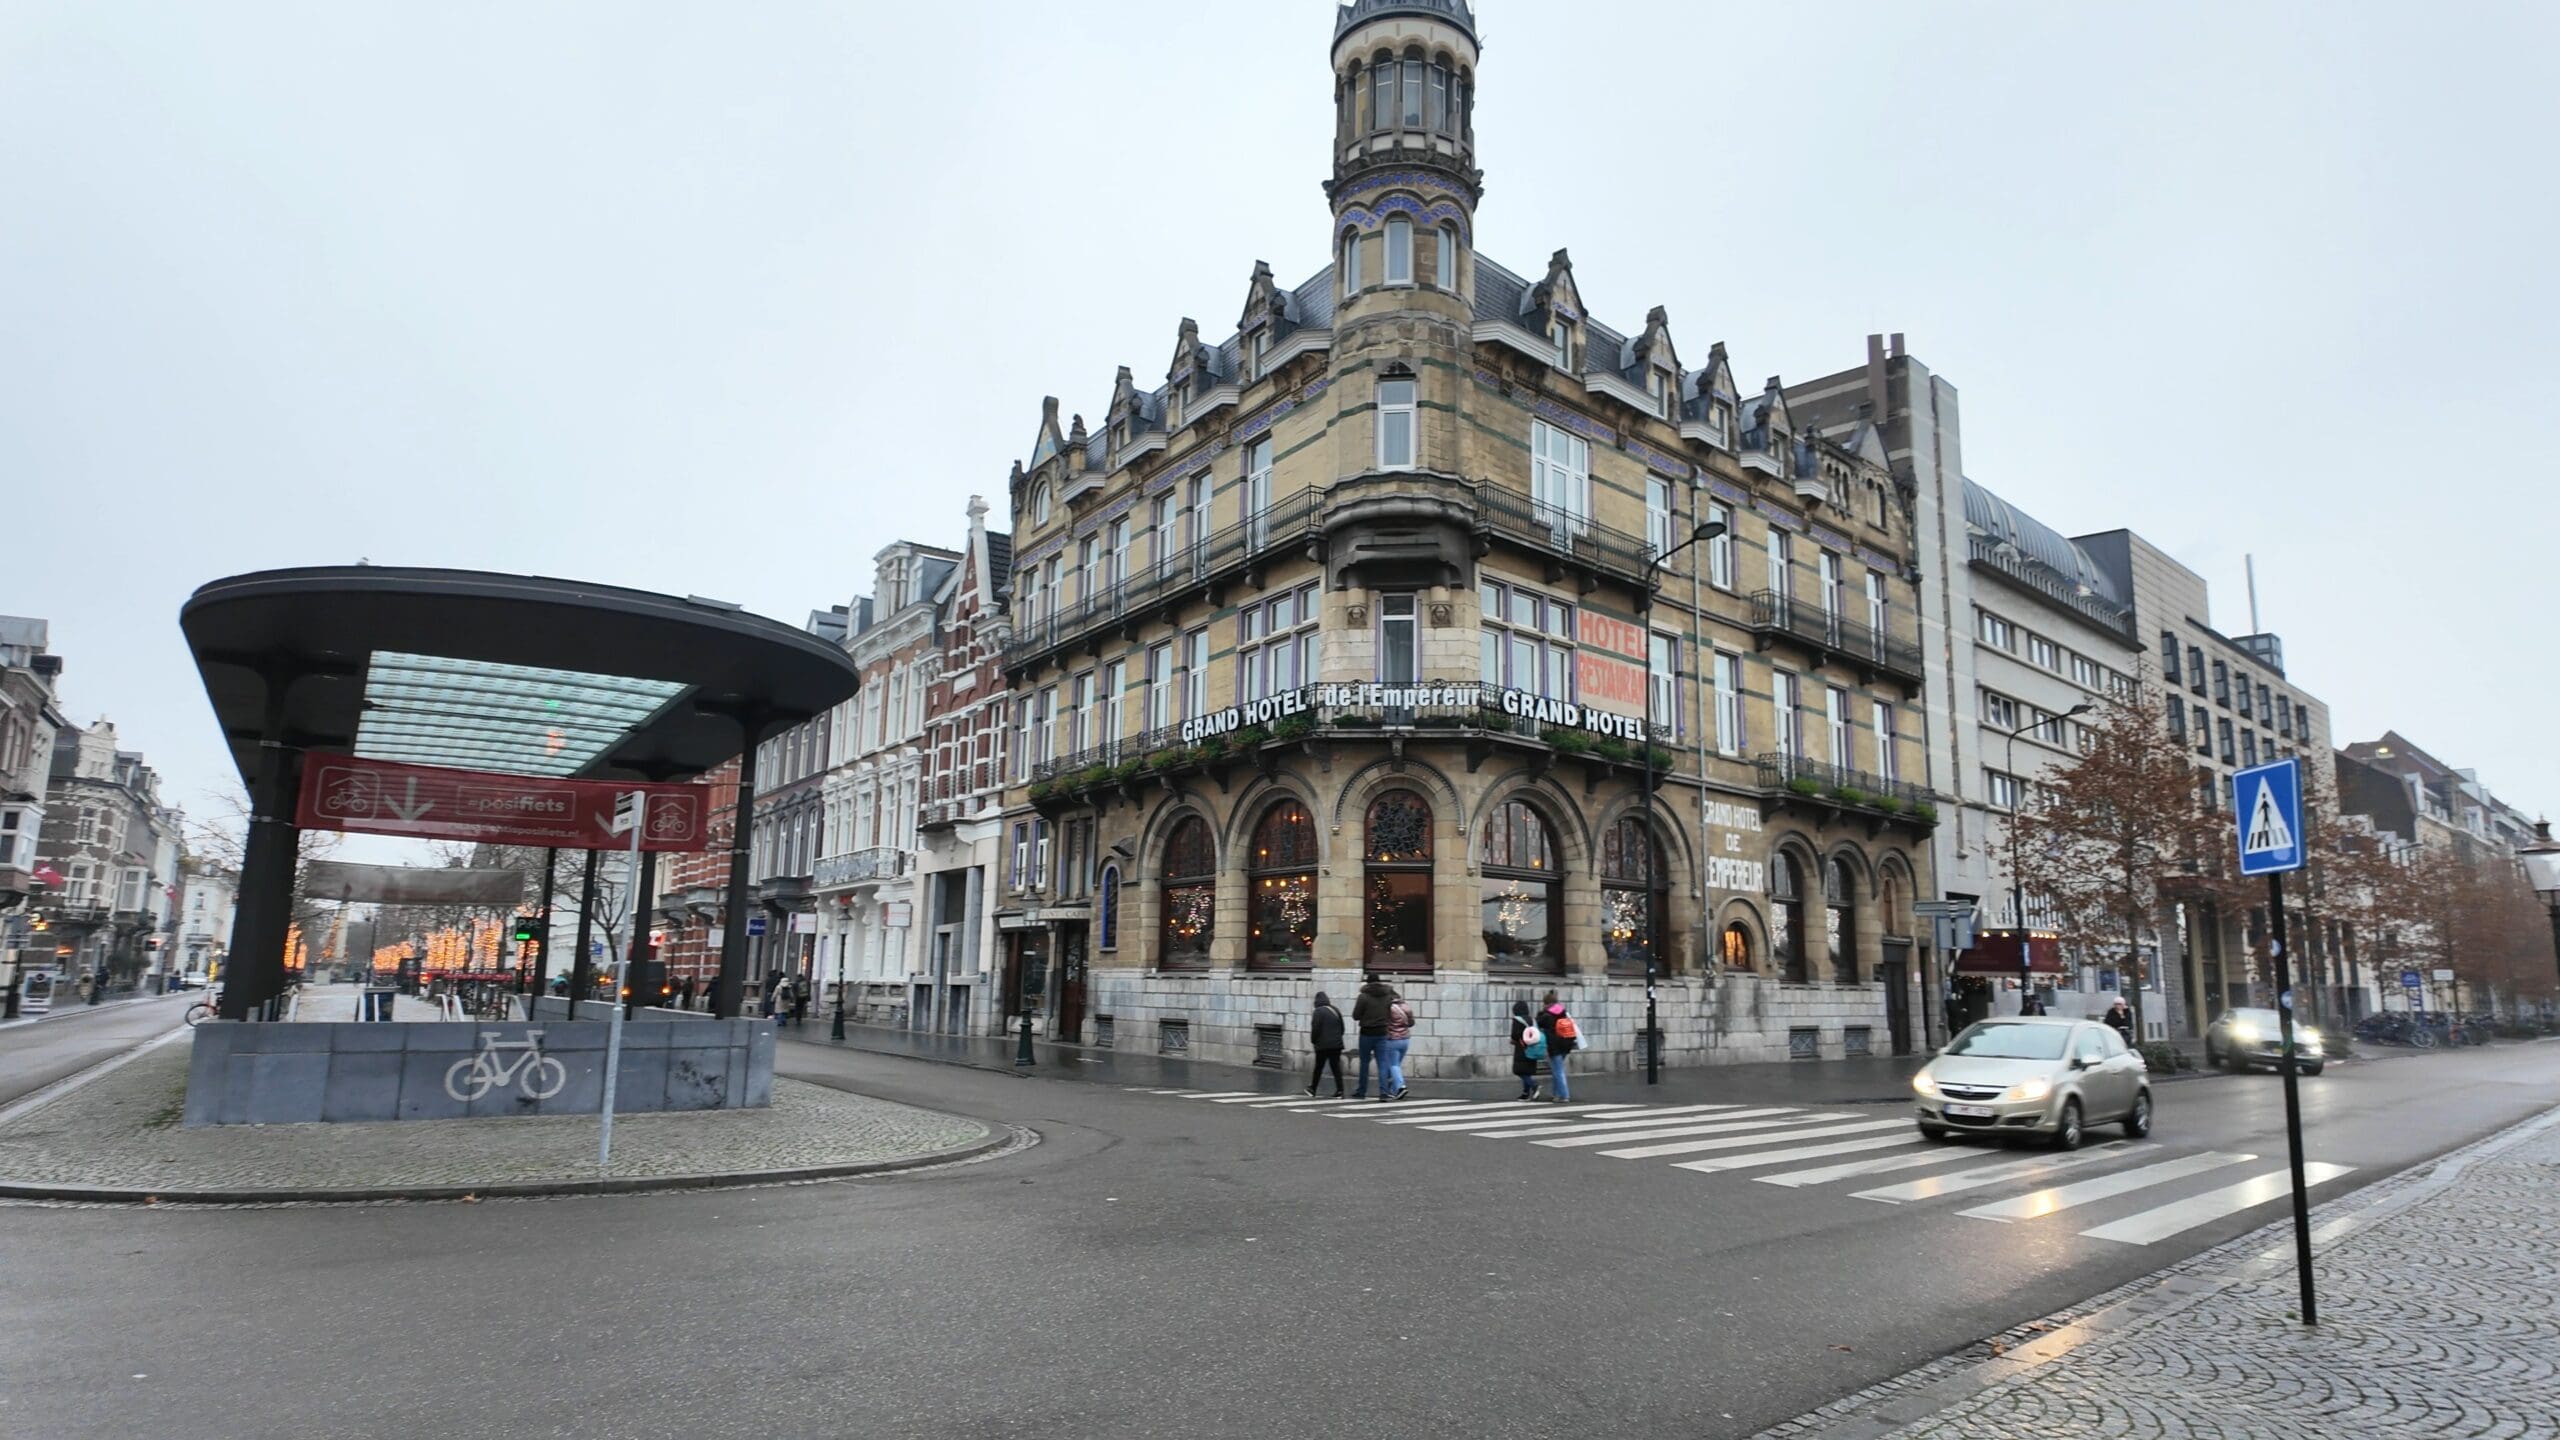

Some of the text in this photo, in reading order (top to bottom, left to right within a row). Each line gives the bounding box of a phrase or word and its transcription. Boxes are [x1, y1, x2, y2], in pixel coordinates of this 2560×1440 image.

[1580, 609, 1647, 660] HOTEL
[1325, 684, 1480, 710] de l'Empereur
[1577, 653, 1647, 707] RESTAURAN
[1182, 689, 1307, 742] GRAND HOTEL
[1503, 689, 1647, 742] GRAND HOTEL
[1726, 833, 1742, 852] DE
[1734, 805, 1762, 833] HOTEL
